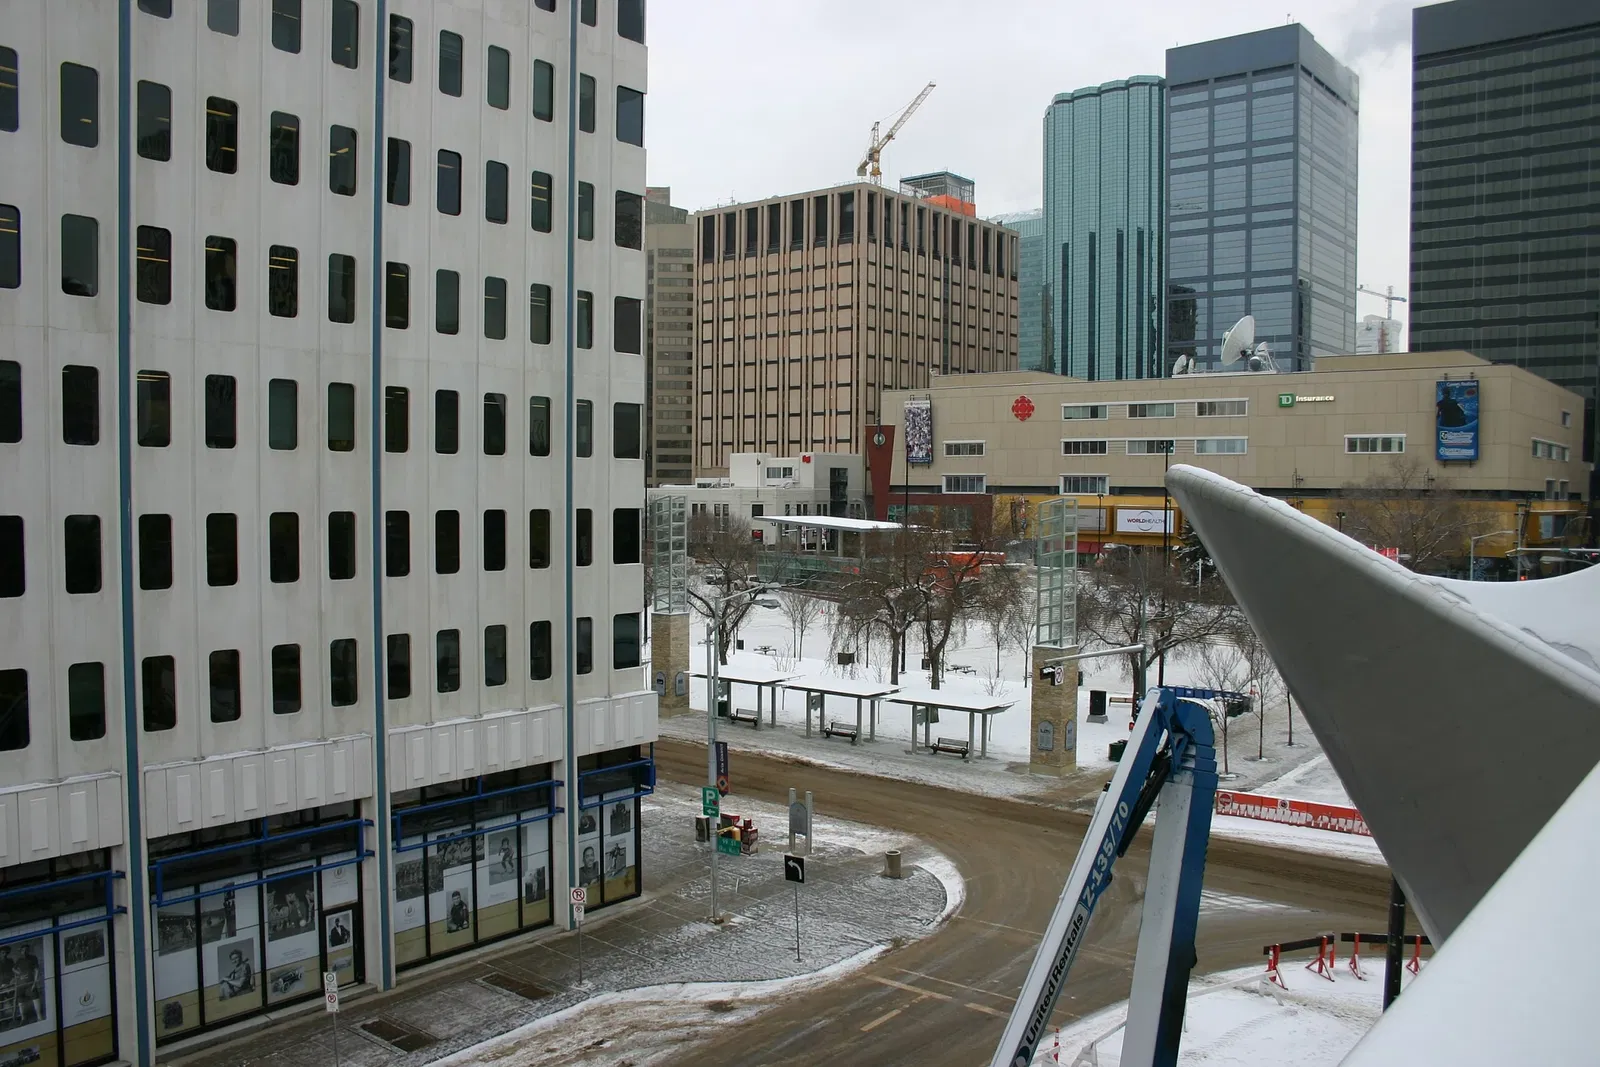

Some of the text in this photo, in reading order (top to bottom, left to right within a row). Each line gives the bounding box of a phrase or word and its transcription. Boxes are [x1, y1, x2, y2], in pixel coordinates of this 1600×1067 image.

[1279, 395, 1292, 405] TD
[1083, 801, 1130, 903] Z-135/70
[1025, 914, 1085, 1047] United Rentals
